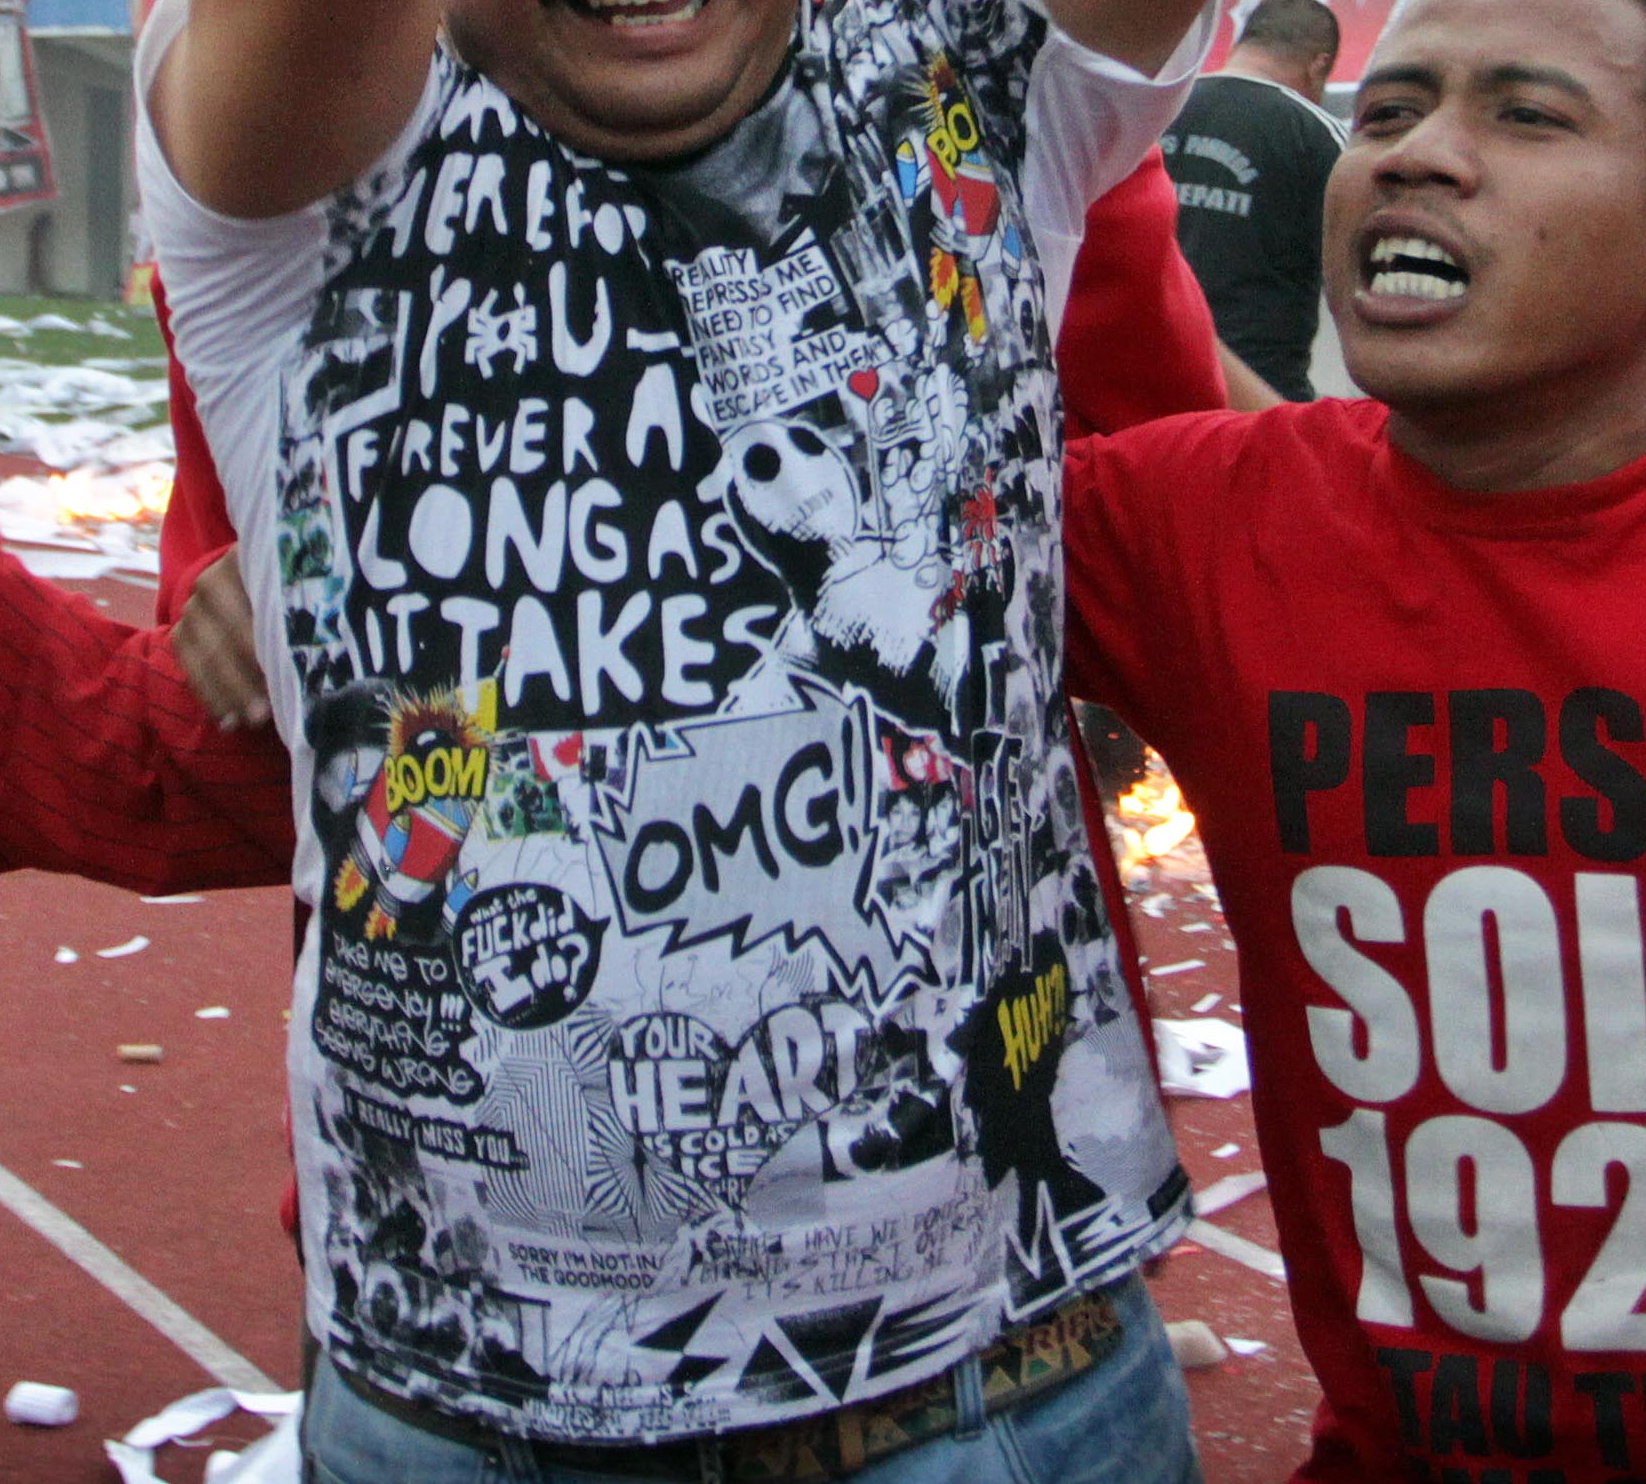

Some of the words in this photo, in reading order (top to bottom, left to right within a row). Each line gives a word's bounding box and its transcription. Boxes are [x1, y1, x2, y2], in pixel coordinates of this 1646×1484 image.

[671, 251, 749, 288] REALITY
[748, 304, 773, 327] TO
[777, 275, 836, 315] FIND
[793, 331, 847, 368] AND
[791, 368, 820, 398] IN
[357, 476, 629, 593] LONG
[648, 499, 742, 585] AS
[365, 592, 431, 675] IT
[440, 589, 779, 717] TAKES
[383, 747, 489, 814] BOOM
[623, 714, 860, 915] OMG!
[507, 888, 537, 910] the
[461, 912, 531, 969] FUCK
[529, 892, 575, 942] did
[413, 956, 448, 987] TO
[472, 954, 533, 1015] I
[530, 931, 590, 1003] do?
[620, 1015, 721, 1062] YOUR
[381, 1057, 475, 1096] WRONG
[608, 1002, 871, 1135] HEART
[357, 1099, 412, 1140] REALLY
[421, 1120, 466, 1159] MISS
[643, 1130, 674, 1159] IS
[680, 1124, 759, 1157] COLD
[680, 1146, 770, 1180] ICE
[508, 1242, 559, 1267] SORRY
[517, 1263, 551, 1285] THE
[1376, 1347, 1556, 1459] TAU
